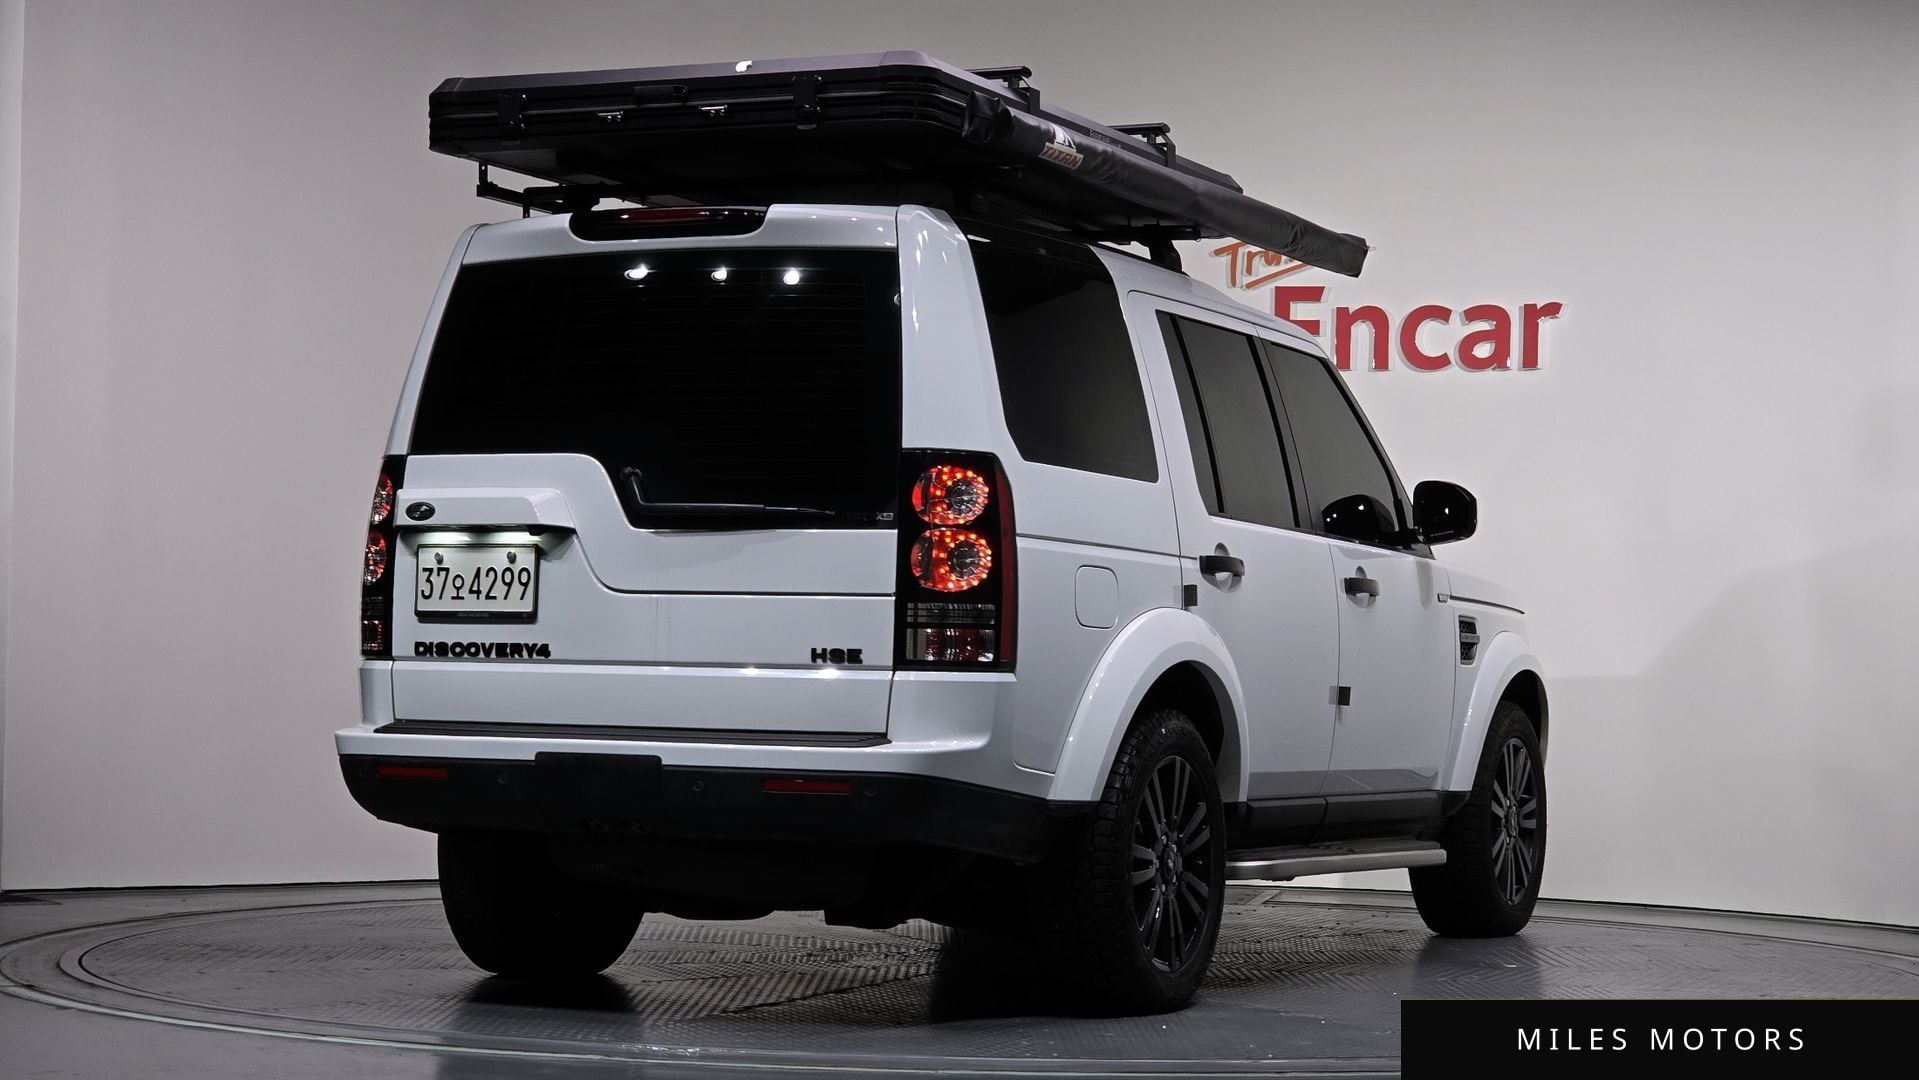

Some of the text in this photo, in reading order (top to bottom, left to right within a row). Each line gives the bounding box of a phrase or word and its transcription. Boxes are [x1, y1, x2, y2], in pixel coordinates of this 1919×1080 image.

[1040, 144, 1082, 168] TITAN
[1274, 286, 1563, 371] Encar
[420, 565, 532, 601] 37오4299
[810, 647, 863, 664] HSE
